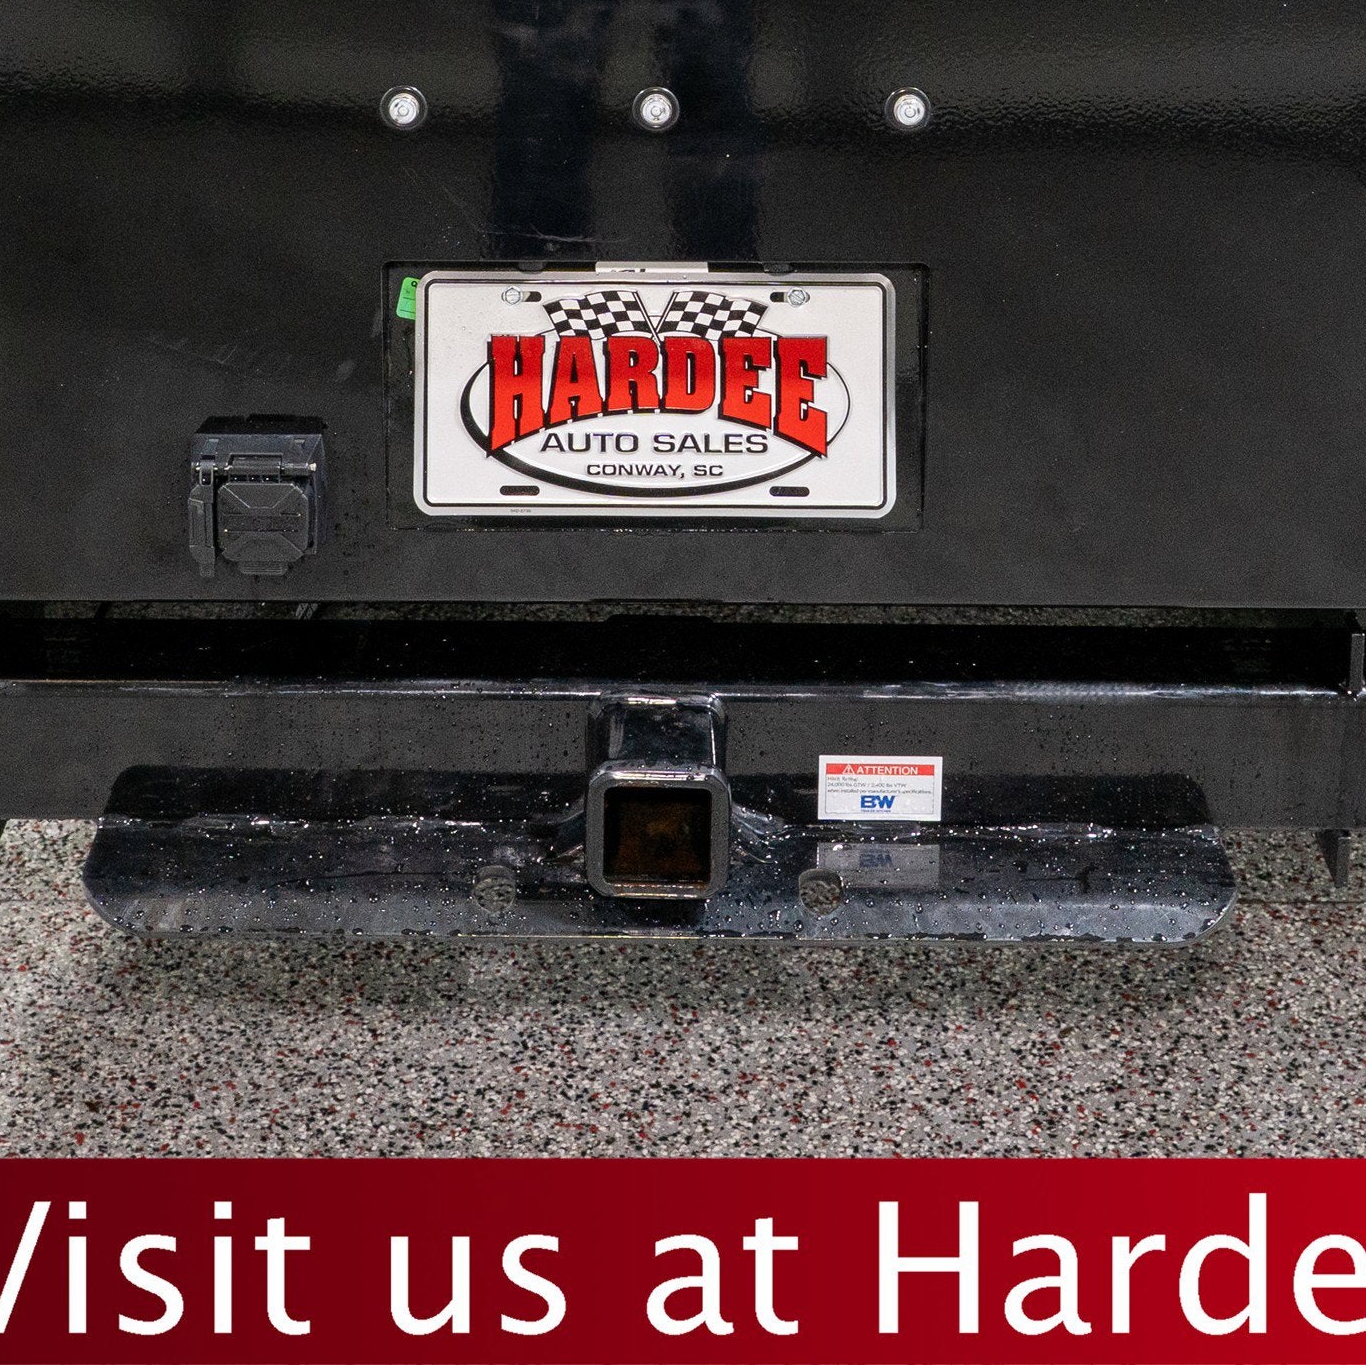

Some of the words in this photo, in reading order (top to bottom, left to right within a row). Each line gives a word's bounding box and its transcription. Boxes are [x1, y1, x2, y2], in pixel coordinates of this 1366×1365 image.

[488, 335, 828, 457] HARDEE
[540, 432, 639, 454] AUTO
[653, 432, 769, 454] SALES
[586, 464, 685, 479] CONWAY,
[693, 464, 724, 478] SC
[856, 765, 918, 775] ATTENTION
